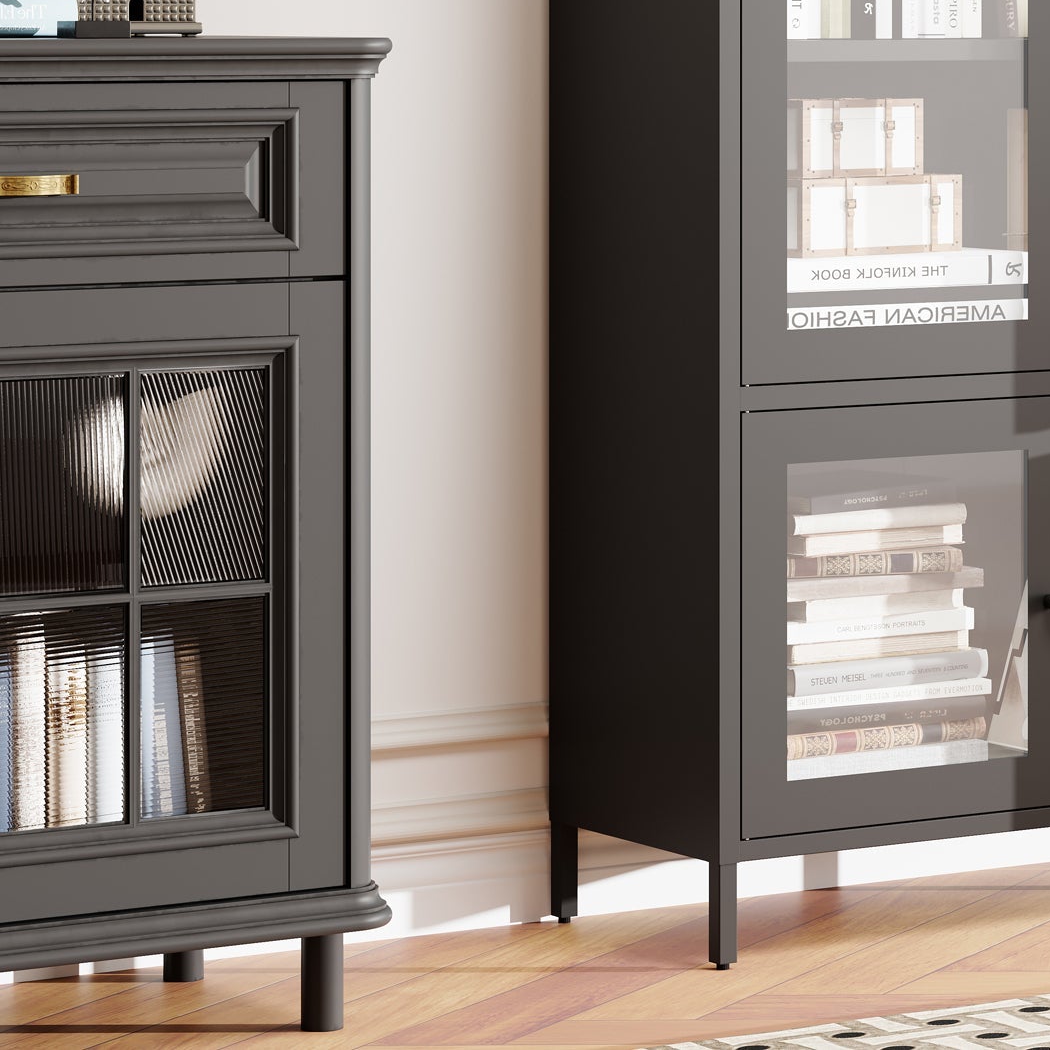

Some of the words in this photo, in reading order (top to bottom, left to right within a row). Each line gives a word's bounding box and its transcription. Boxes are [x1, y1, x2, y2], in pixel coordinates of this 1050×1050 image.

[892, 619, 926, 629] PORTRAITS
[810, 676, 838, 687] STEVEN
[841, 673, 867, 683] MEISEL
[924, 687, 941, 696] FROM
[944, 684, 984, 695] EVERMOTION
